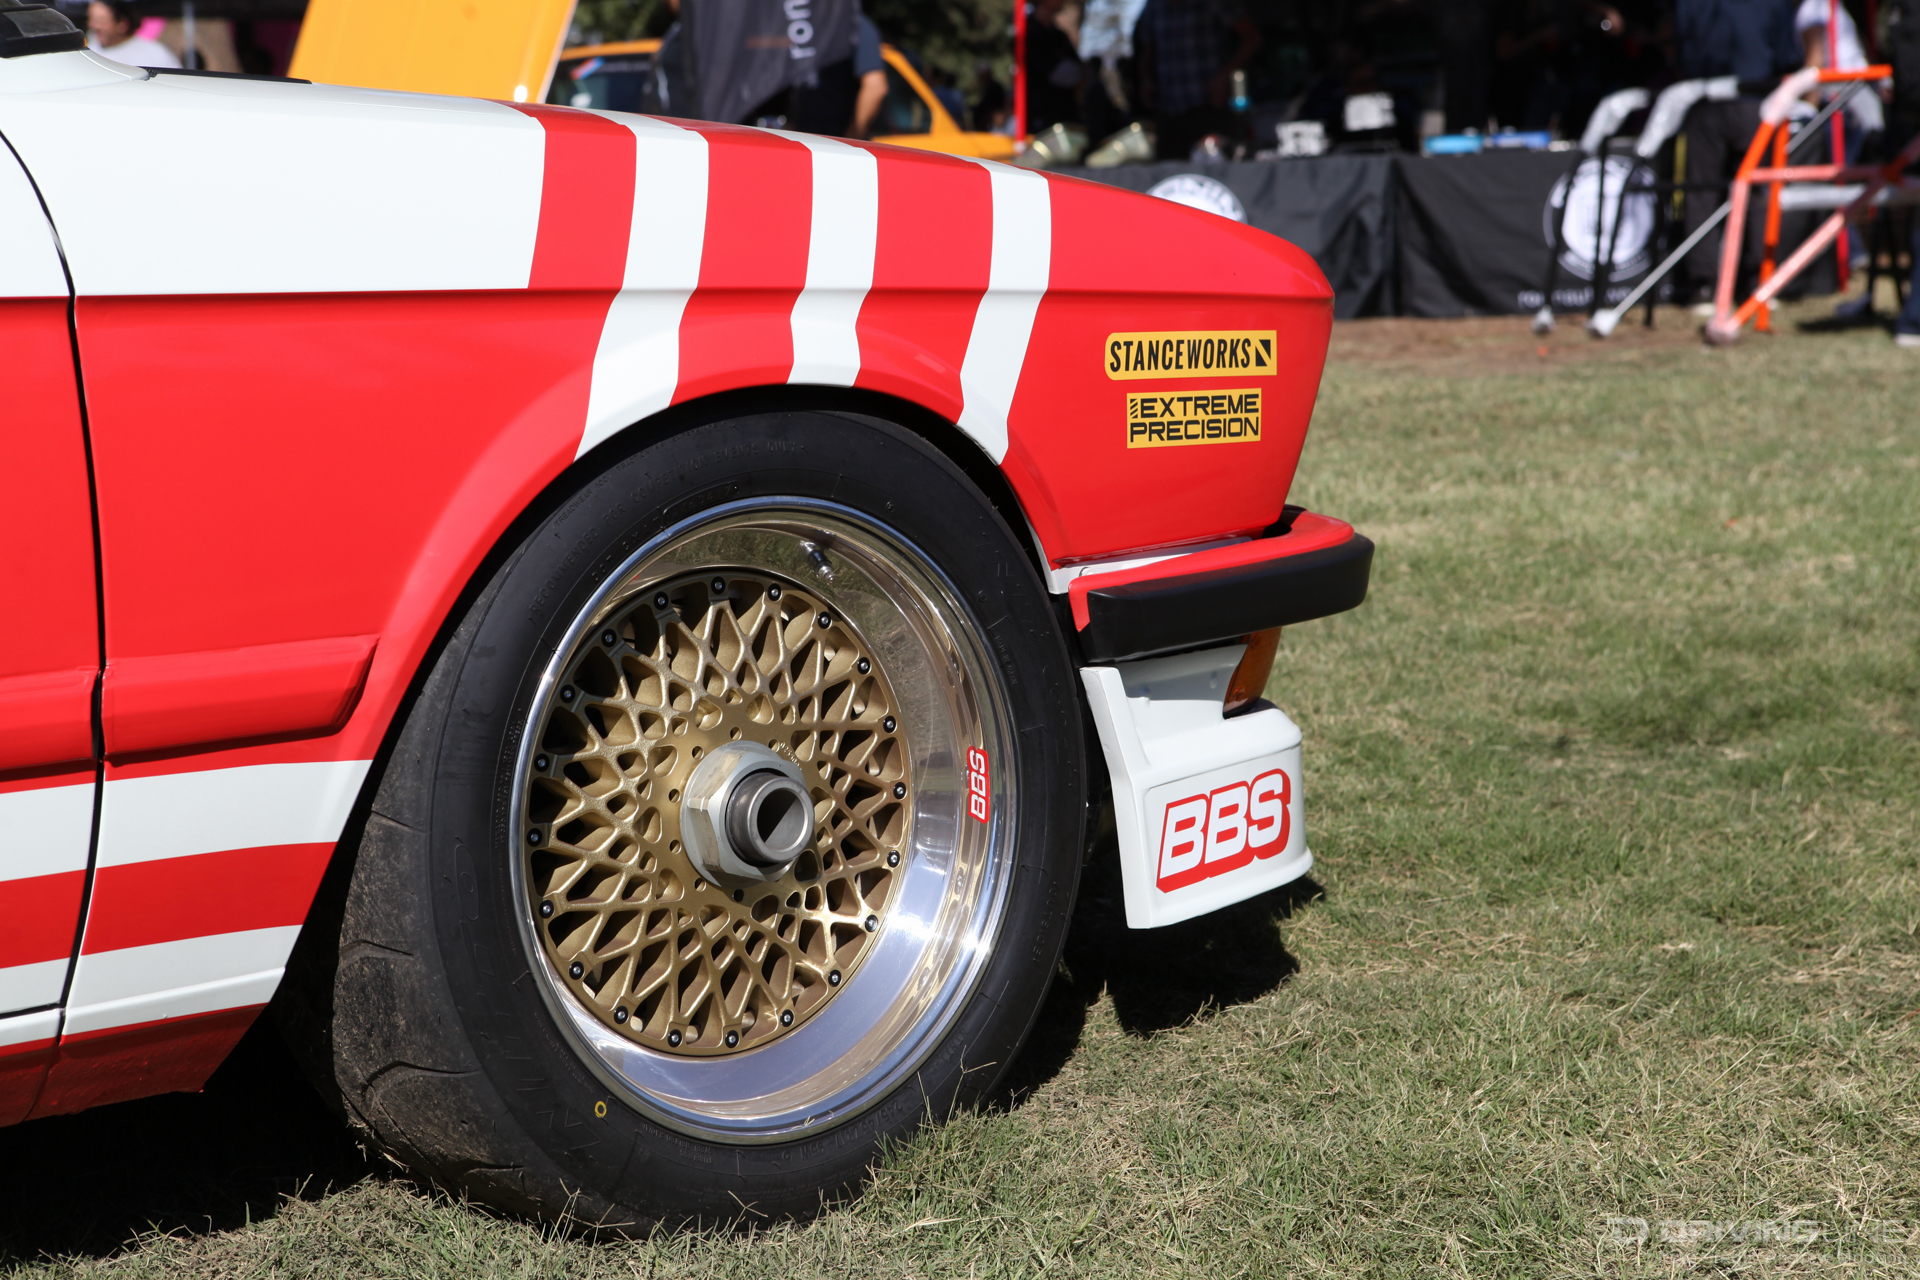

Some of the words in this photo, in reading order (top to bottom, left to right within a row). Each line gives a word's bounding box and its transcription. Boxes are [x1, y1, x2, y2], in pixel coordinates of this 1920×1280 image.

[1110, 338, 1251, 373] STANCEWORKS
[1130, 417, 1259, 443] PRECISION
[1140, 394, 1259, 418] EXTREME
[529, 527, 598, 614] RECOMMENDED
[970, 749, 986, 820] BBS
[1157, 769, 1290, 892] BBS
